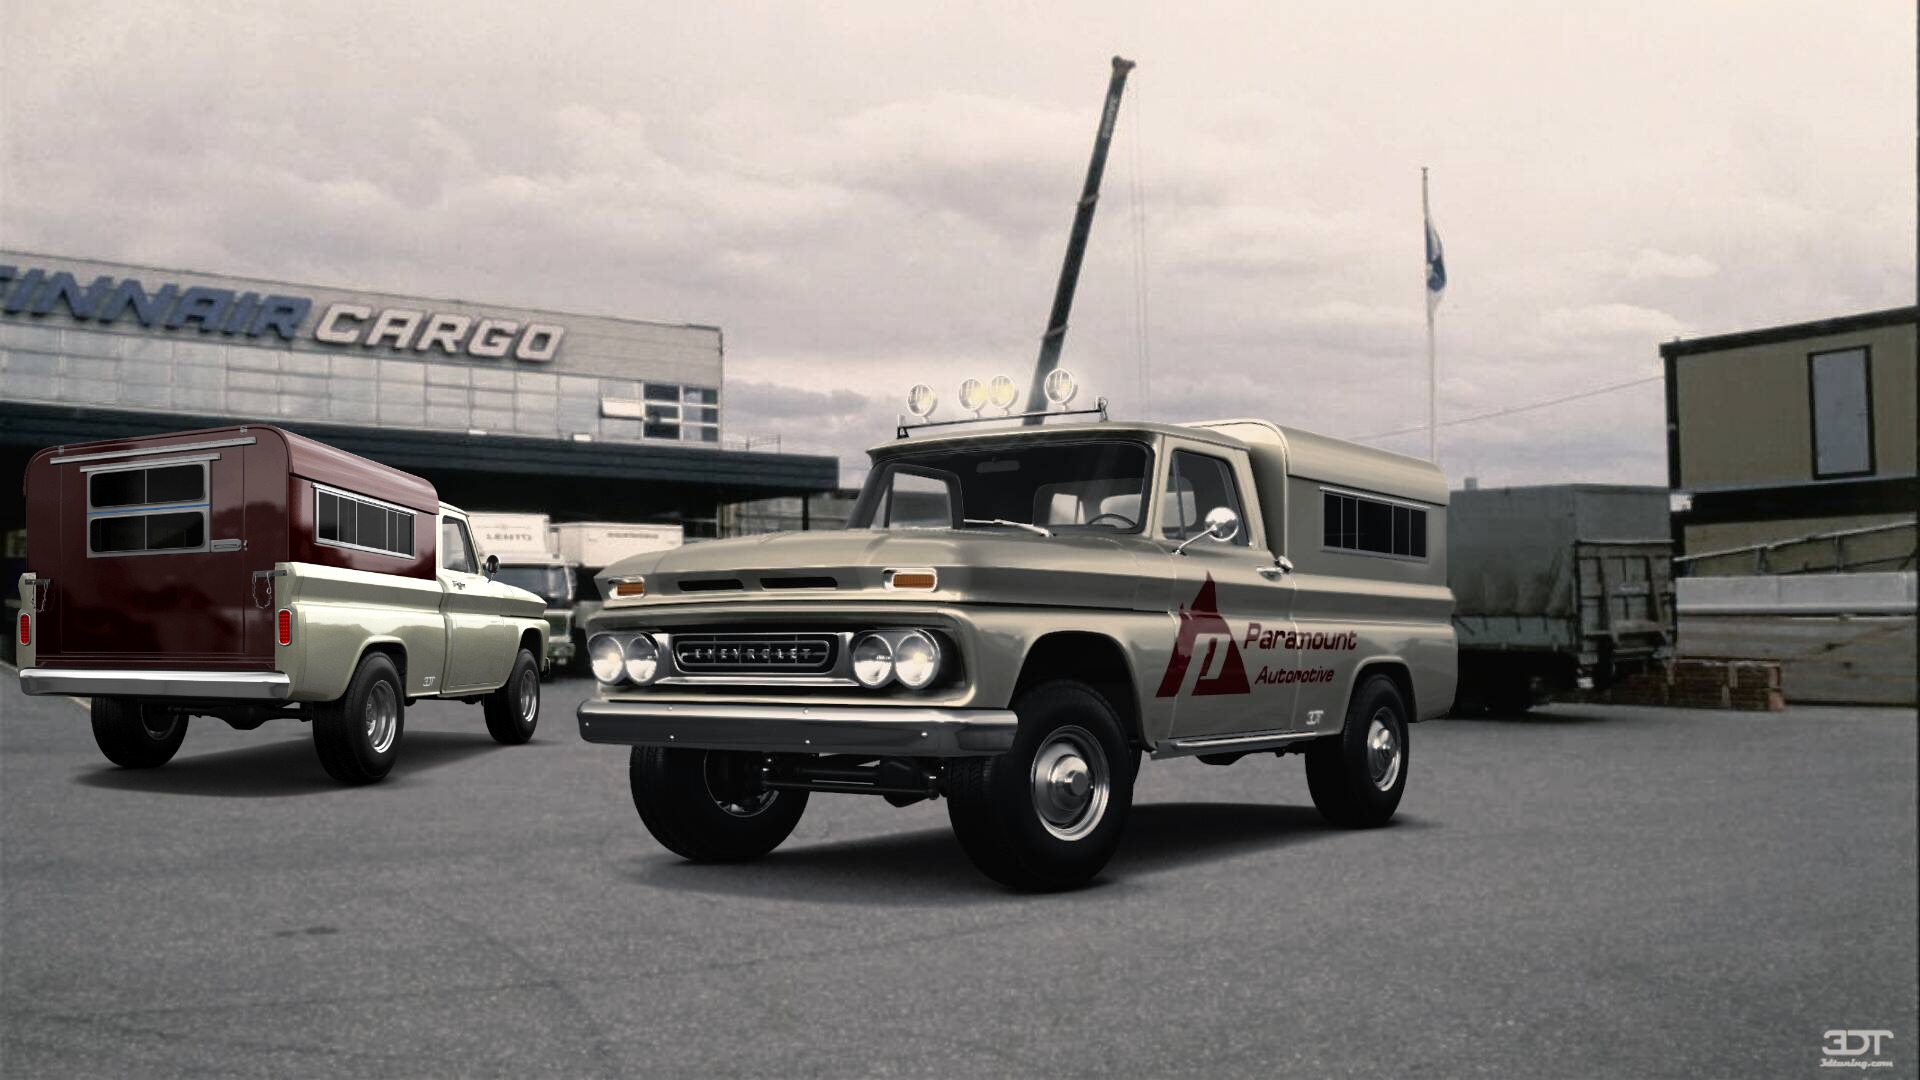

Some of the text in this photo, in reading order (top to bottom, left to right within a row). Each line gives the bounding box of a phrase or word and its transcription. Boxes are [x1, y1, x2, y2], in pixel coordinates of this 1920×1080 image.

[315, 303, 565, 362] CARGO
[1244, 622, 1357, 650] Paramount
[695, 648, 812, 660] CHEVROLET
[1255, 666, 1335, 685] Automotive
